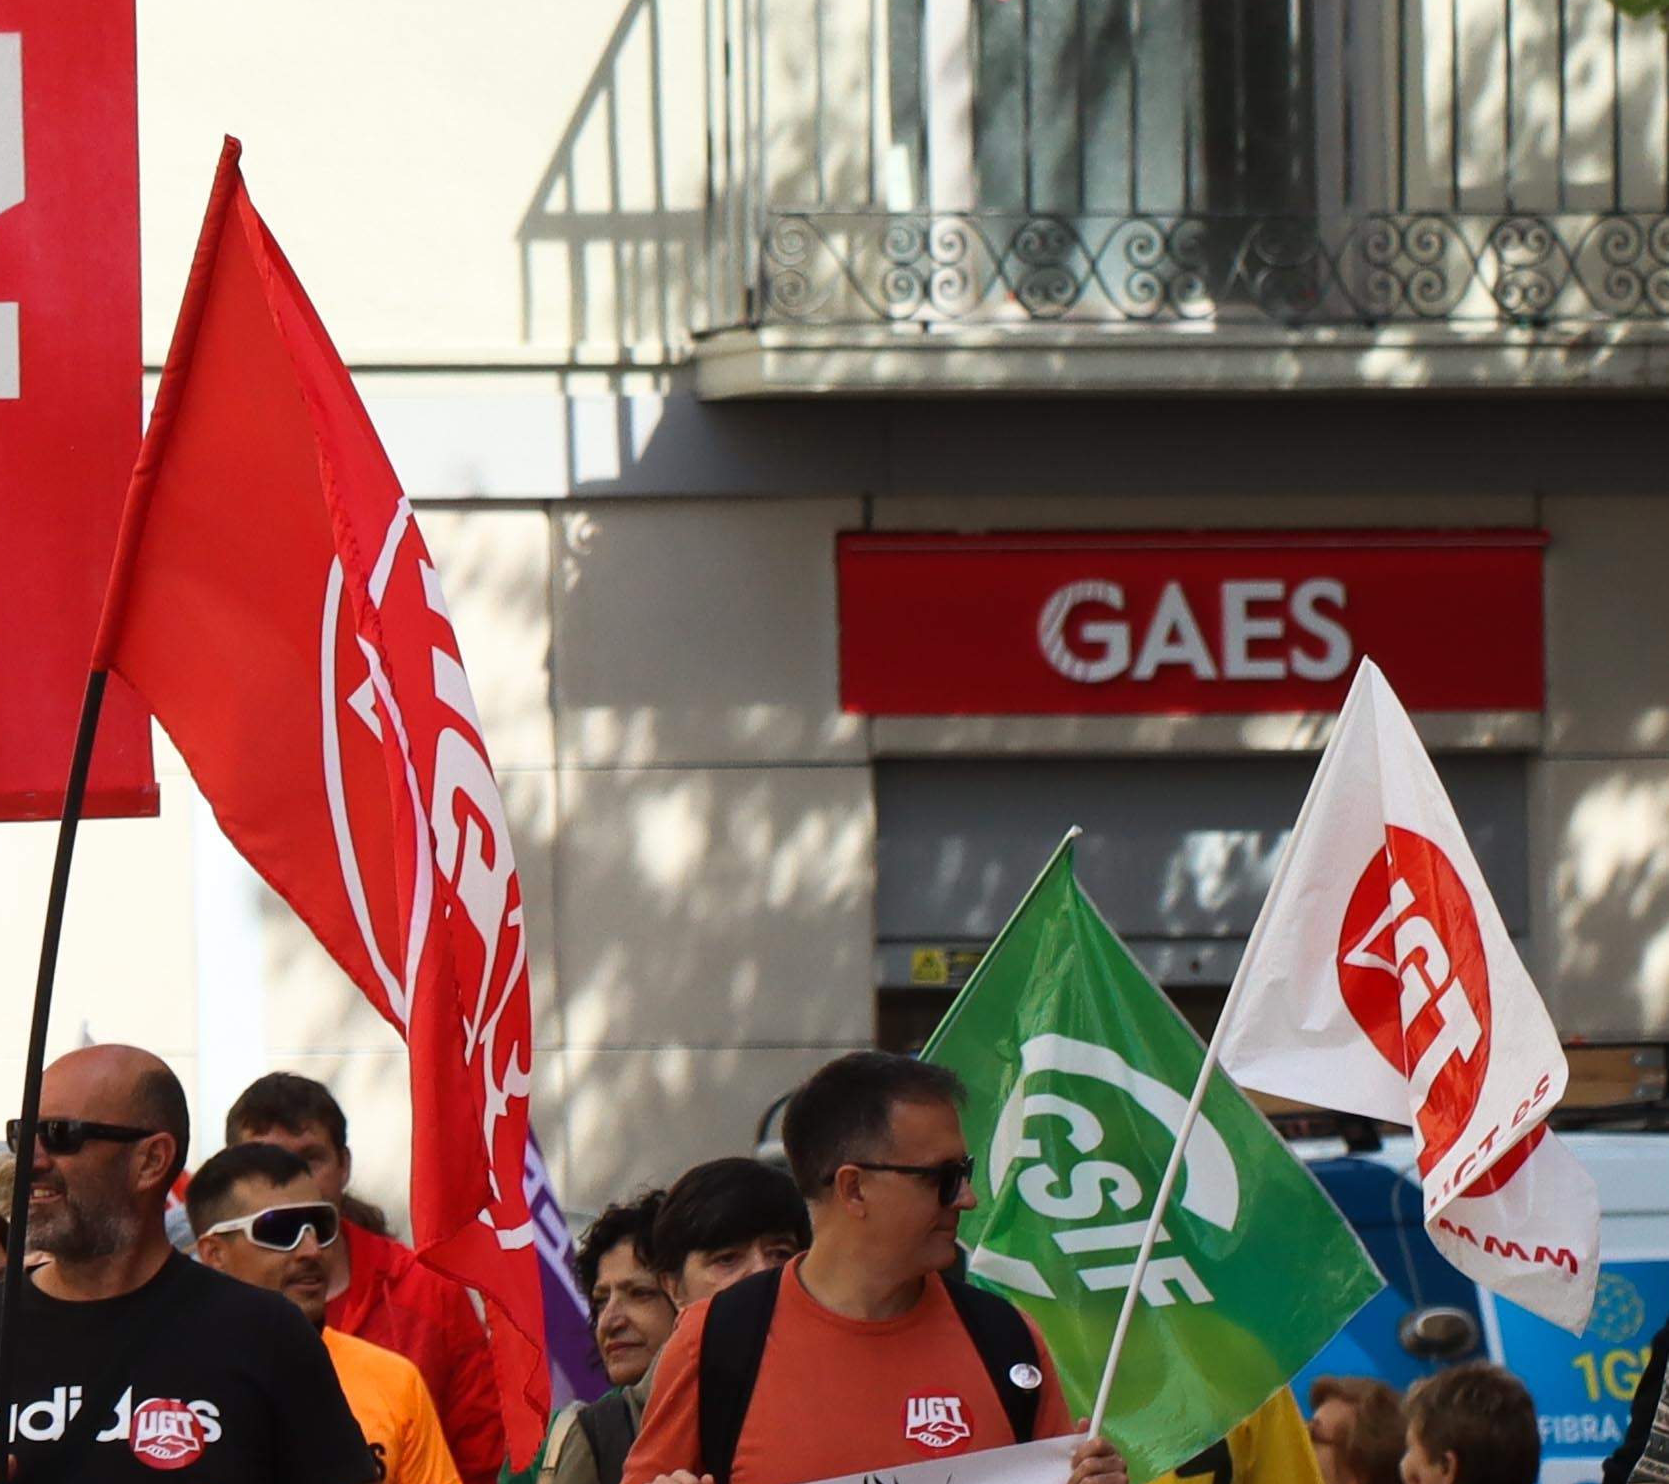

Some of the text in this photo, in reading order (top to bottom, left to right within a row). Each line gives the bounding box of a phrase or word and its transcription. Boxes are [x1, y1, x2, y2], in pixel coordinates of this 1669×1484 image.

[1037, 578, 1355, 682] GAES
[1015, 1093, 1216, 1308] CSIF
[136, 1410, 194, 1441] UGT
[906, 1395, 963, 1426] UGT
